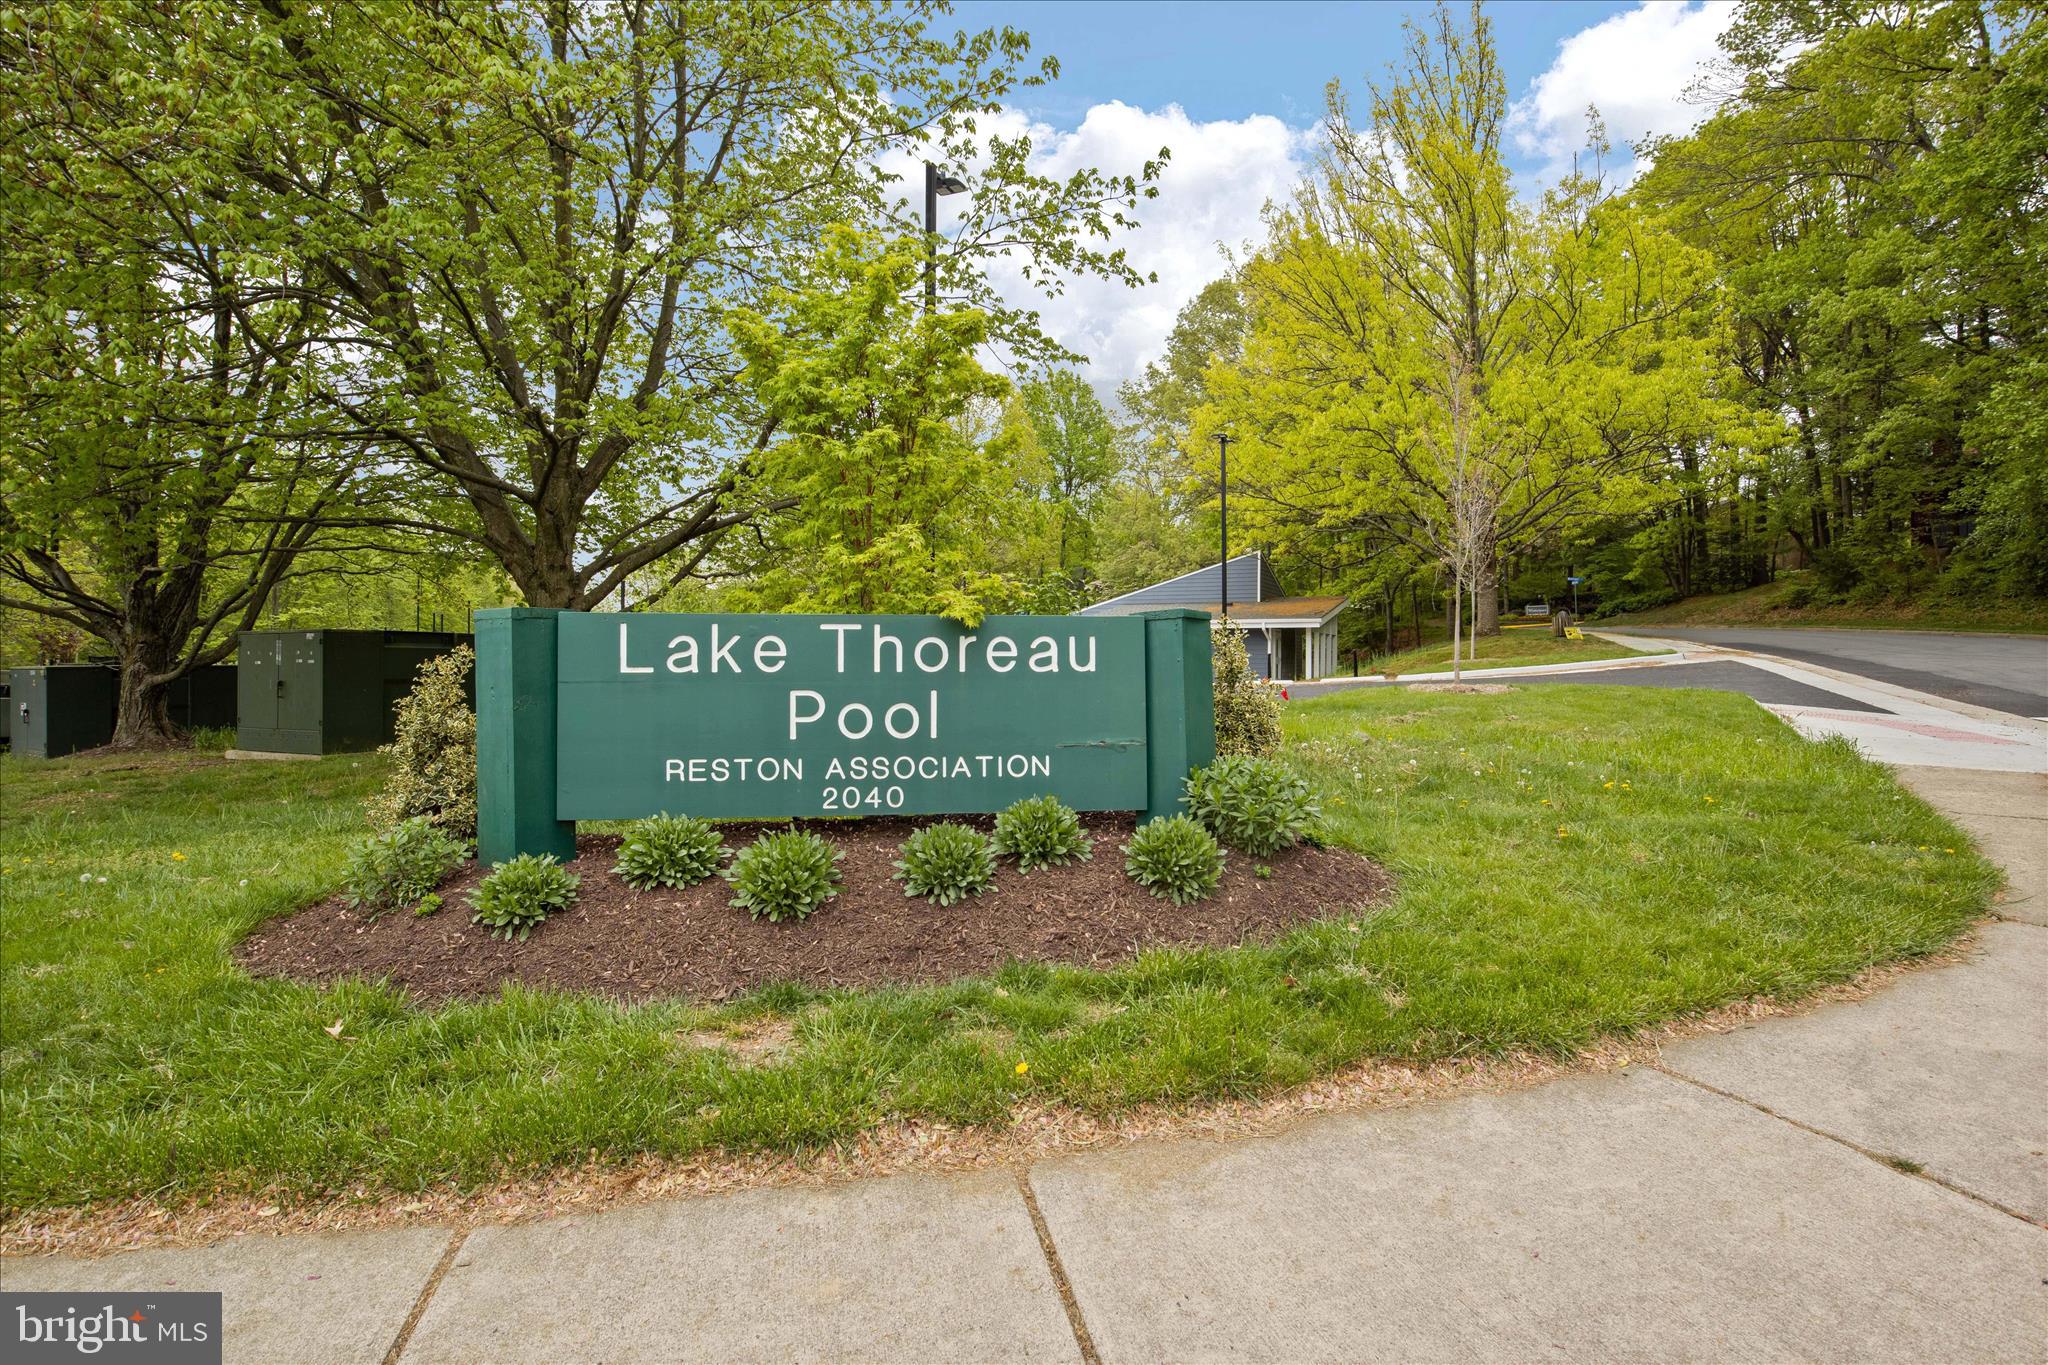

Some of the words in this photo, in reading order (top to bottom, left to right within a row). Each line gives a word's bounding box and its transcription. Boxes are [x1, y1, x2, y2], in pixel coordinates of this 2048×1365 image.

[619, 622, 787, 674] Lake
[819, 623, 1097, 673] Thoreau
[788, 689, 938, 740] Pool
[665, 757, 803, 782] RESTON
[824, 754, 1051, 780] ASSOCIATION
[822, 785, 905, 810] 2040
